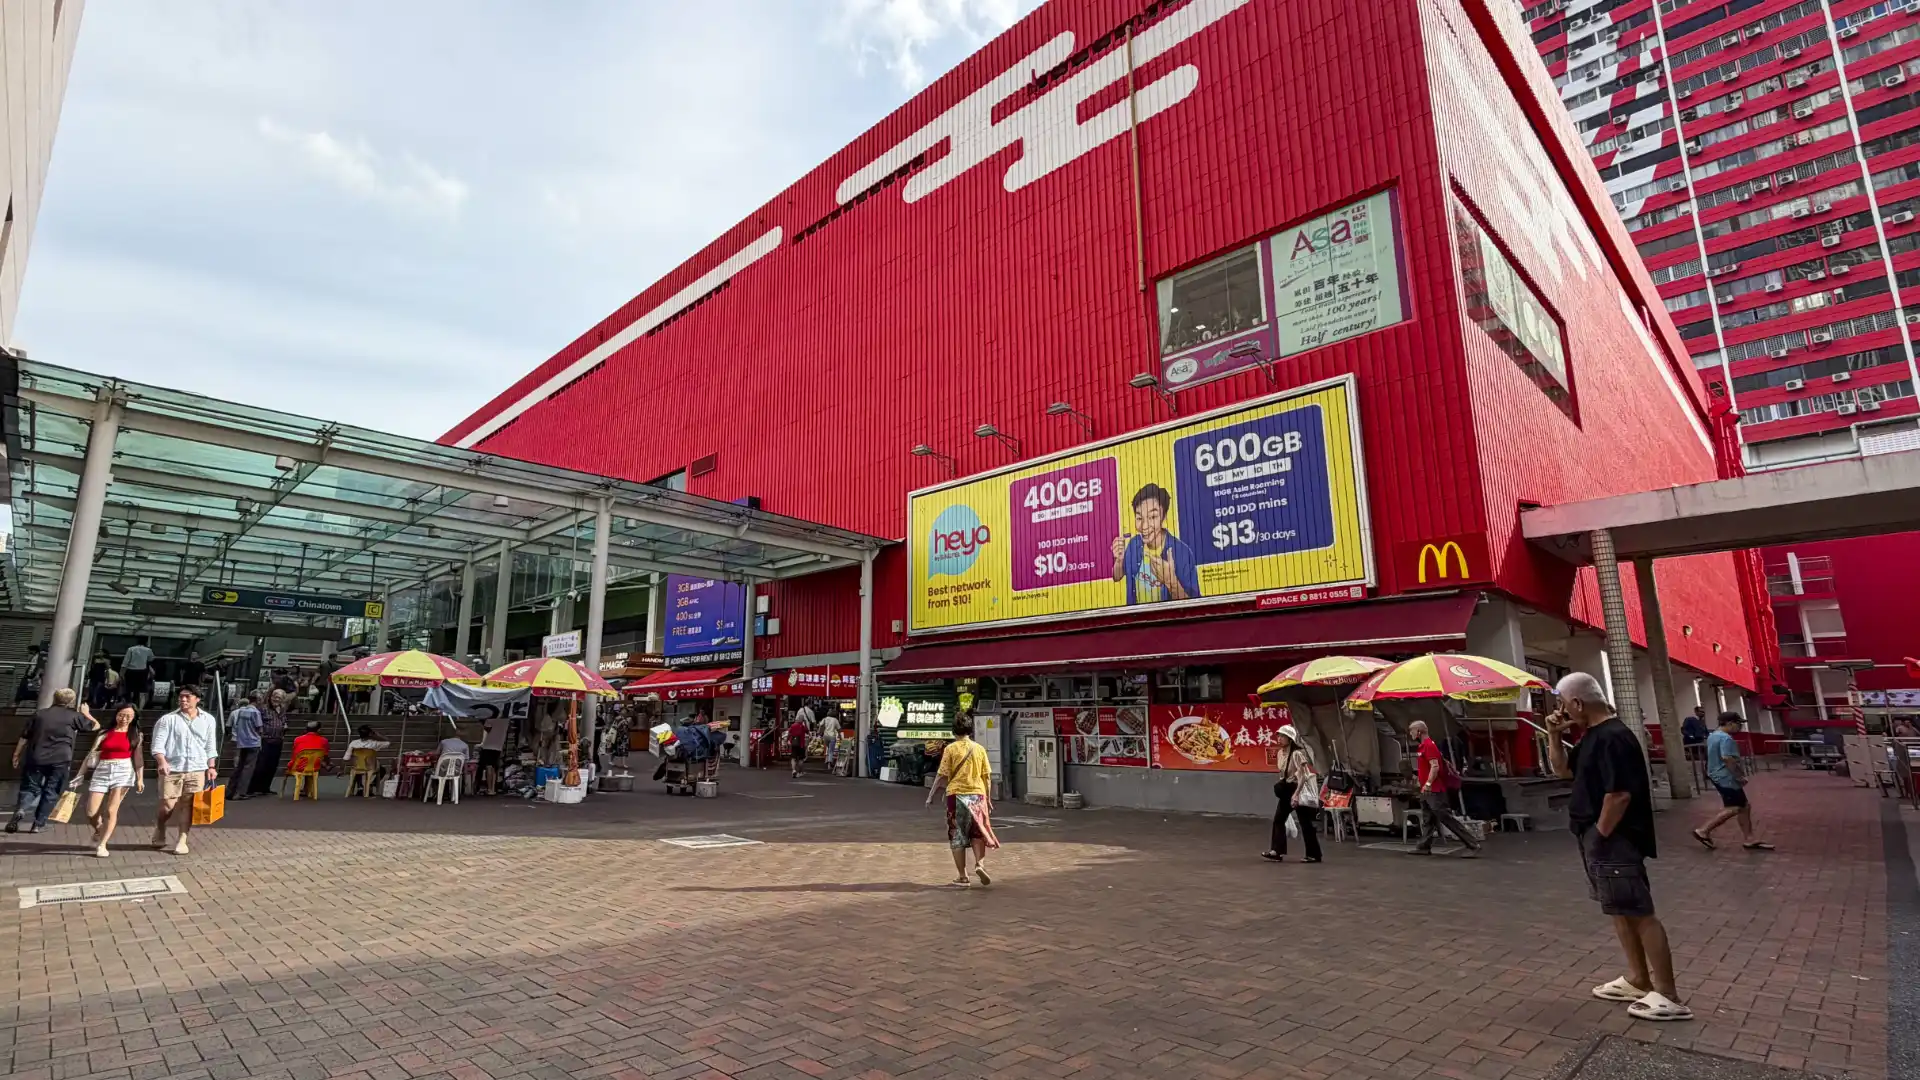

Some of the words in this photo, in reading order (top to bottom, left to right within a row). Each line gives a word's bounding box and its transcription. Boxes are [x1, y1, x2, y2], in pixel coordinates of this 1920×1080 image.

[1290, 219, 1352, 261] Asa
[1327, 303, 1346, 316] 100
[1348, 290, 1382, 312] years!
[1300, 329, 1328, 346] Half
[1332, 315, 1377, 337] century!
[1195, 431, 1302, 472] 600GB
[1213, 474, 1224, 482] SG
[1232, 470, 1244, 479] MY
[1272, 461, 1283, 470] TH
[1024, 478, 1102, 510] 400GB
[1214, 488, 1232, 497] 10GB
[1233, 484, 1249, 494] Asia
[1250, 479, 1285, 491] Roaming
[1215, 507, 1235, 518] 500
[1237, 502, 1256, 514] IDD
[1258, 497, 1288, 510] mins
[934, 524, 991, 555] heya
[1038, 541, 1051, 549] 100
[1067, 534, 1088, 545] mins
[1272, 528, 1296, 542] days
[677, 582, 690, 593] 3GB
[928, 585, 949, 597] Best
[950, 578, 991, 595] network
[676, 597, 689, 608] 3GB
[928, 597, 950, 609] from
[952, 594, 972, 606] $10!
[1261, 595, 1299, 606] ADSPACE
[1309, 592, 1328, 601] 8812
[1329, 589, 1349, 598] 0555
[298, 601, 342, 611] Chinatown
[676, 611, 688, 621] 400
[672, 626, 687, 636] FREE
[607, 661, 625, 670] MAGIC
[691, 655, 701, 663] FOR
[701, 654, 713, 662] RENT
[907, 700, 945, 711] Fruiture
